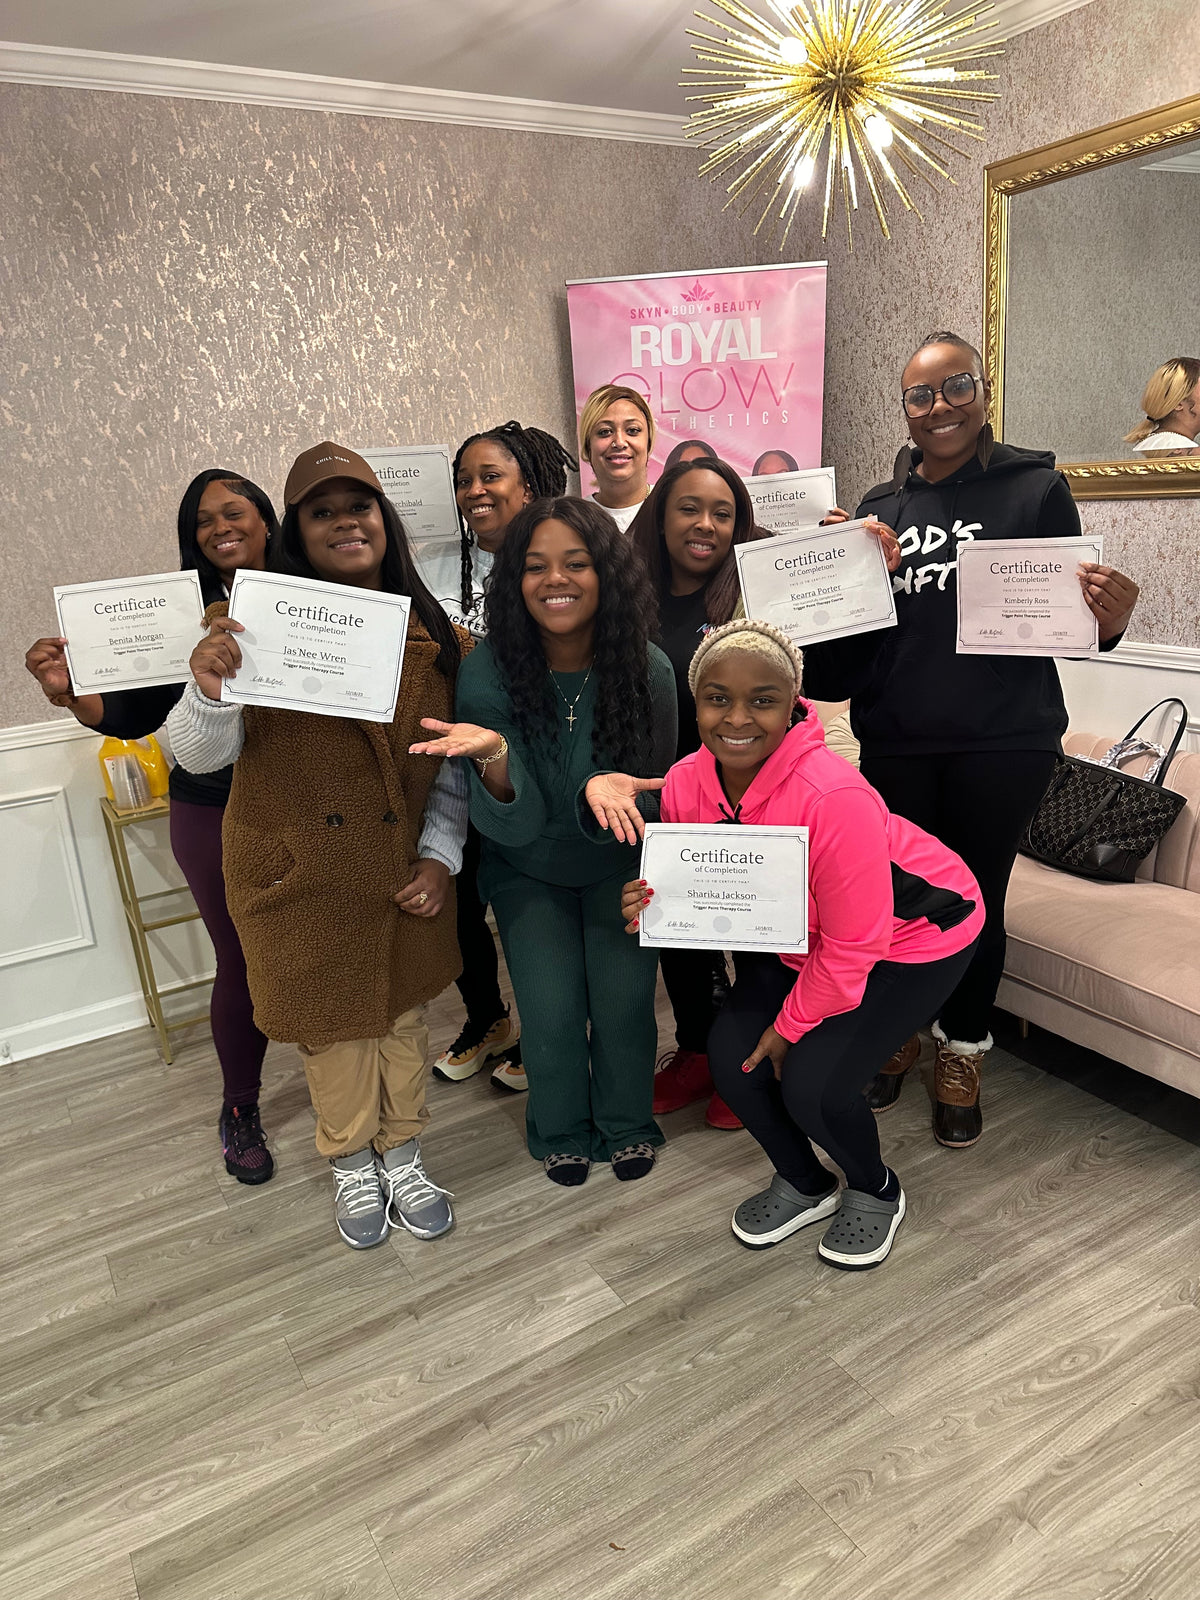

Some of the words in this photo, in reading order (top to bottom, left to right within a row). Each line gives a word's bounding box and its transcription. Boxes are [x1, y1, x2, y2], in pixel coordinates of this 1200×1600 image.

[630, 307, 662, 319] SKYN
[672, 304, 703, 316] BODY
[714, 300, 761, 314] BEAUTY
[630, 317, 777, 368] ROYAL
[654, 410, 789, 431] STHETICS
[316, 456, 332, 465] CHILL
[375, 466, 420, 479] rtificate
[774, 520, 800, 528] Mitchell
[898, 520, 983, 557] OD'S
[774, 548, 846, 570] Certificate
[797, 564, 834, 576] Completion
[990, 560, 1062, 574] Certificate
[1012, 576, 1049, 584] Completion
[790, 590, 816, 600] Kearra
[818, 584, 842, 596] Porter
[94, 597, 166, 614] Certificate
[1004, 597, 1033, 605] Kimberly
[118, 612, 155, 621] Completion
[276, 600, 364, 628] Certificate
[300, 622, 346, 636] Completion
[135, 634, 164, 642] Morgan
[320, 652, 346, 663] Wren
[680, 848, 764, 864] Certificate
[704, 866, 748, 875] Completion
[722, 891, 757, 900] Jackson
